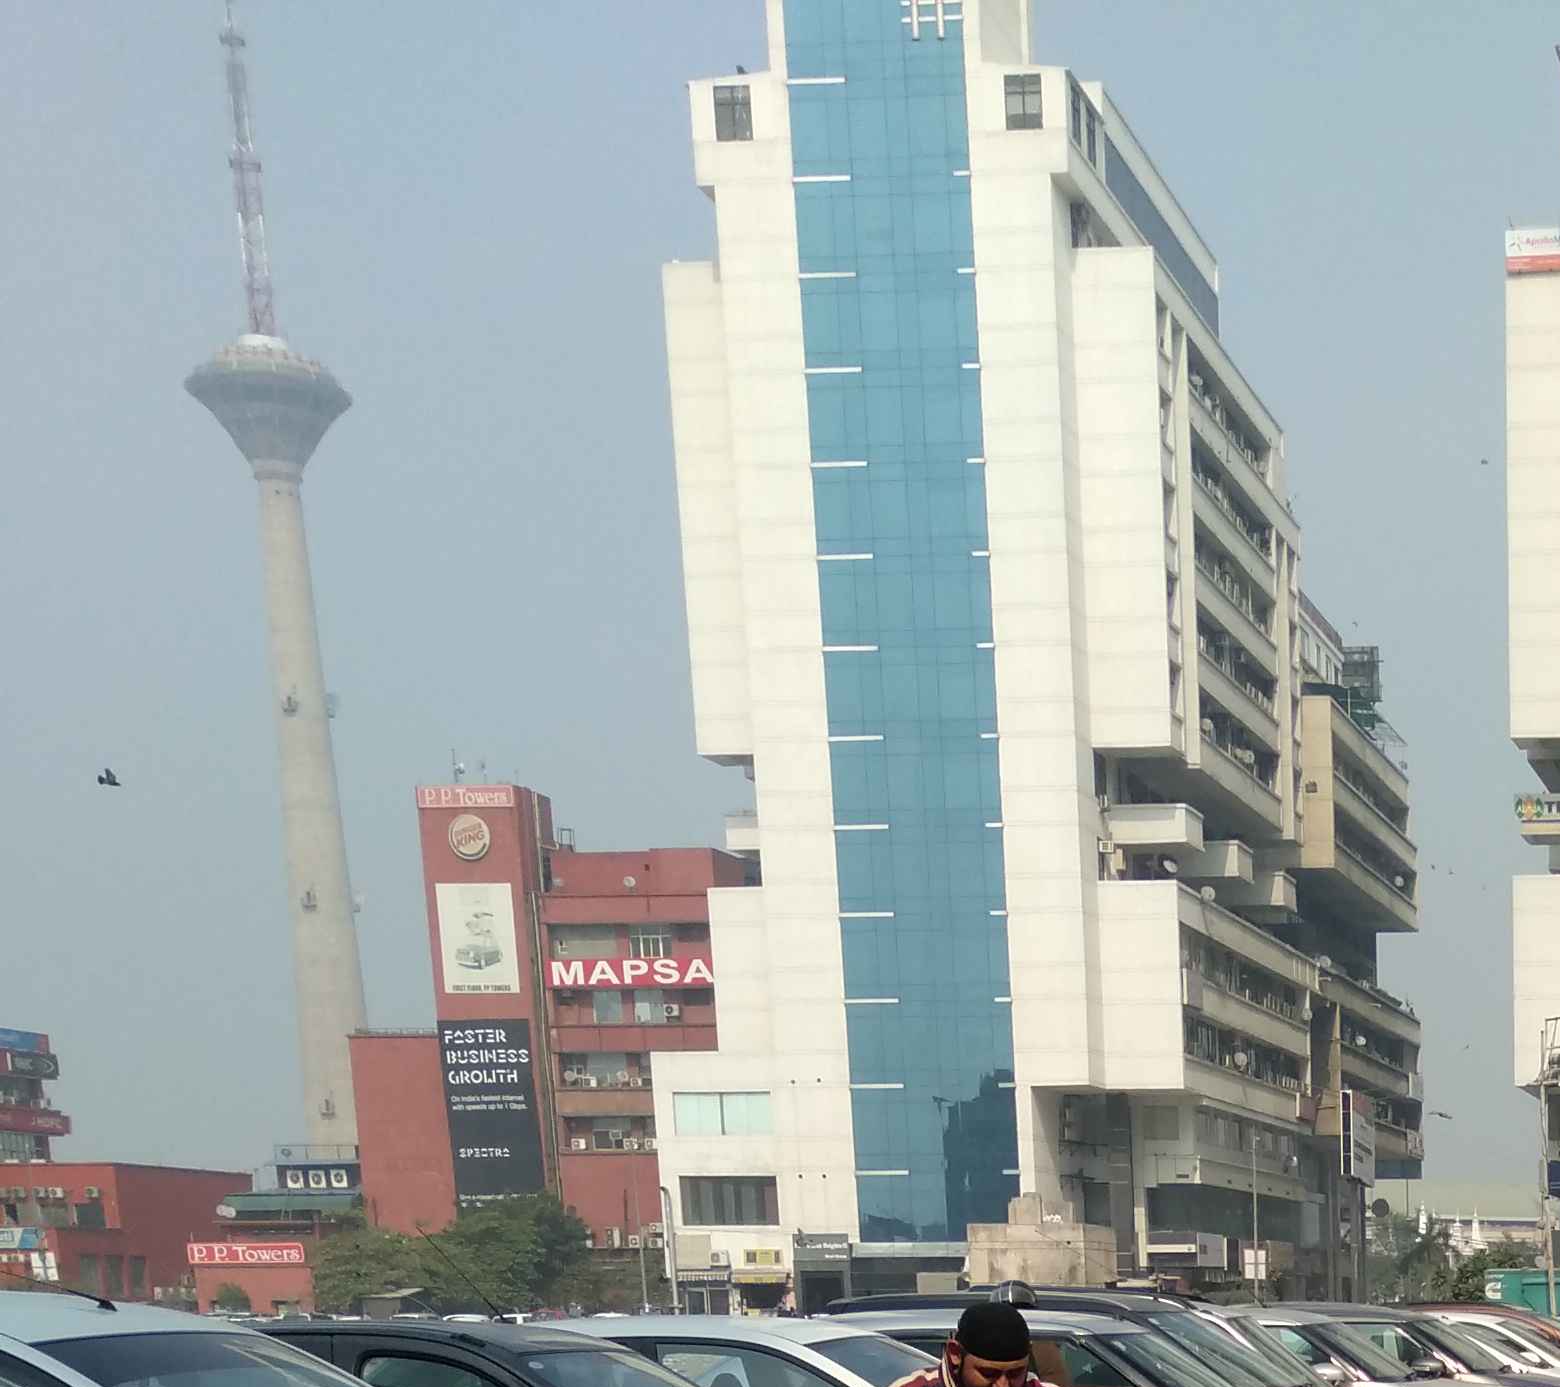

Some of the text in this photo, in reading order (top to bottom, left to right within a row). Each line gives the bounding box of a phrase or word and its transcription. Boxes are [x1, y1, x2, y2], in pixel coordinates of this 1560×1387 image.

[456, 788, 508, 805] Towers
[456, 830, 486, 848] KING
[444, 1028, 507, 1044] FASTER
[446, 1048, 529, 1064] BUSINESS
[448, 1069, 518, 1084] GROWTH
[459, 1147, 511, 1158] SPECTRA
[232, 1246, 300, 1261] Towers
